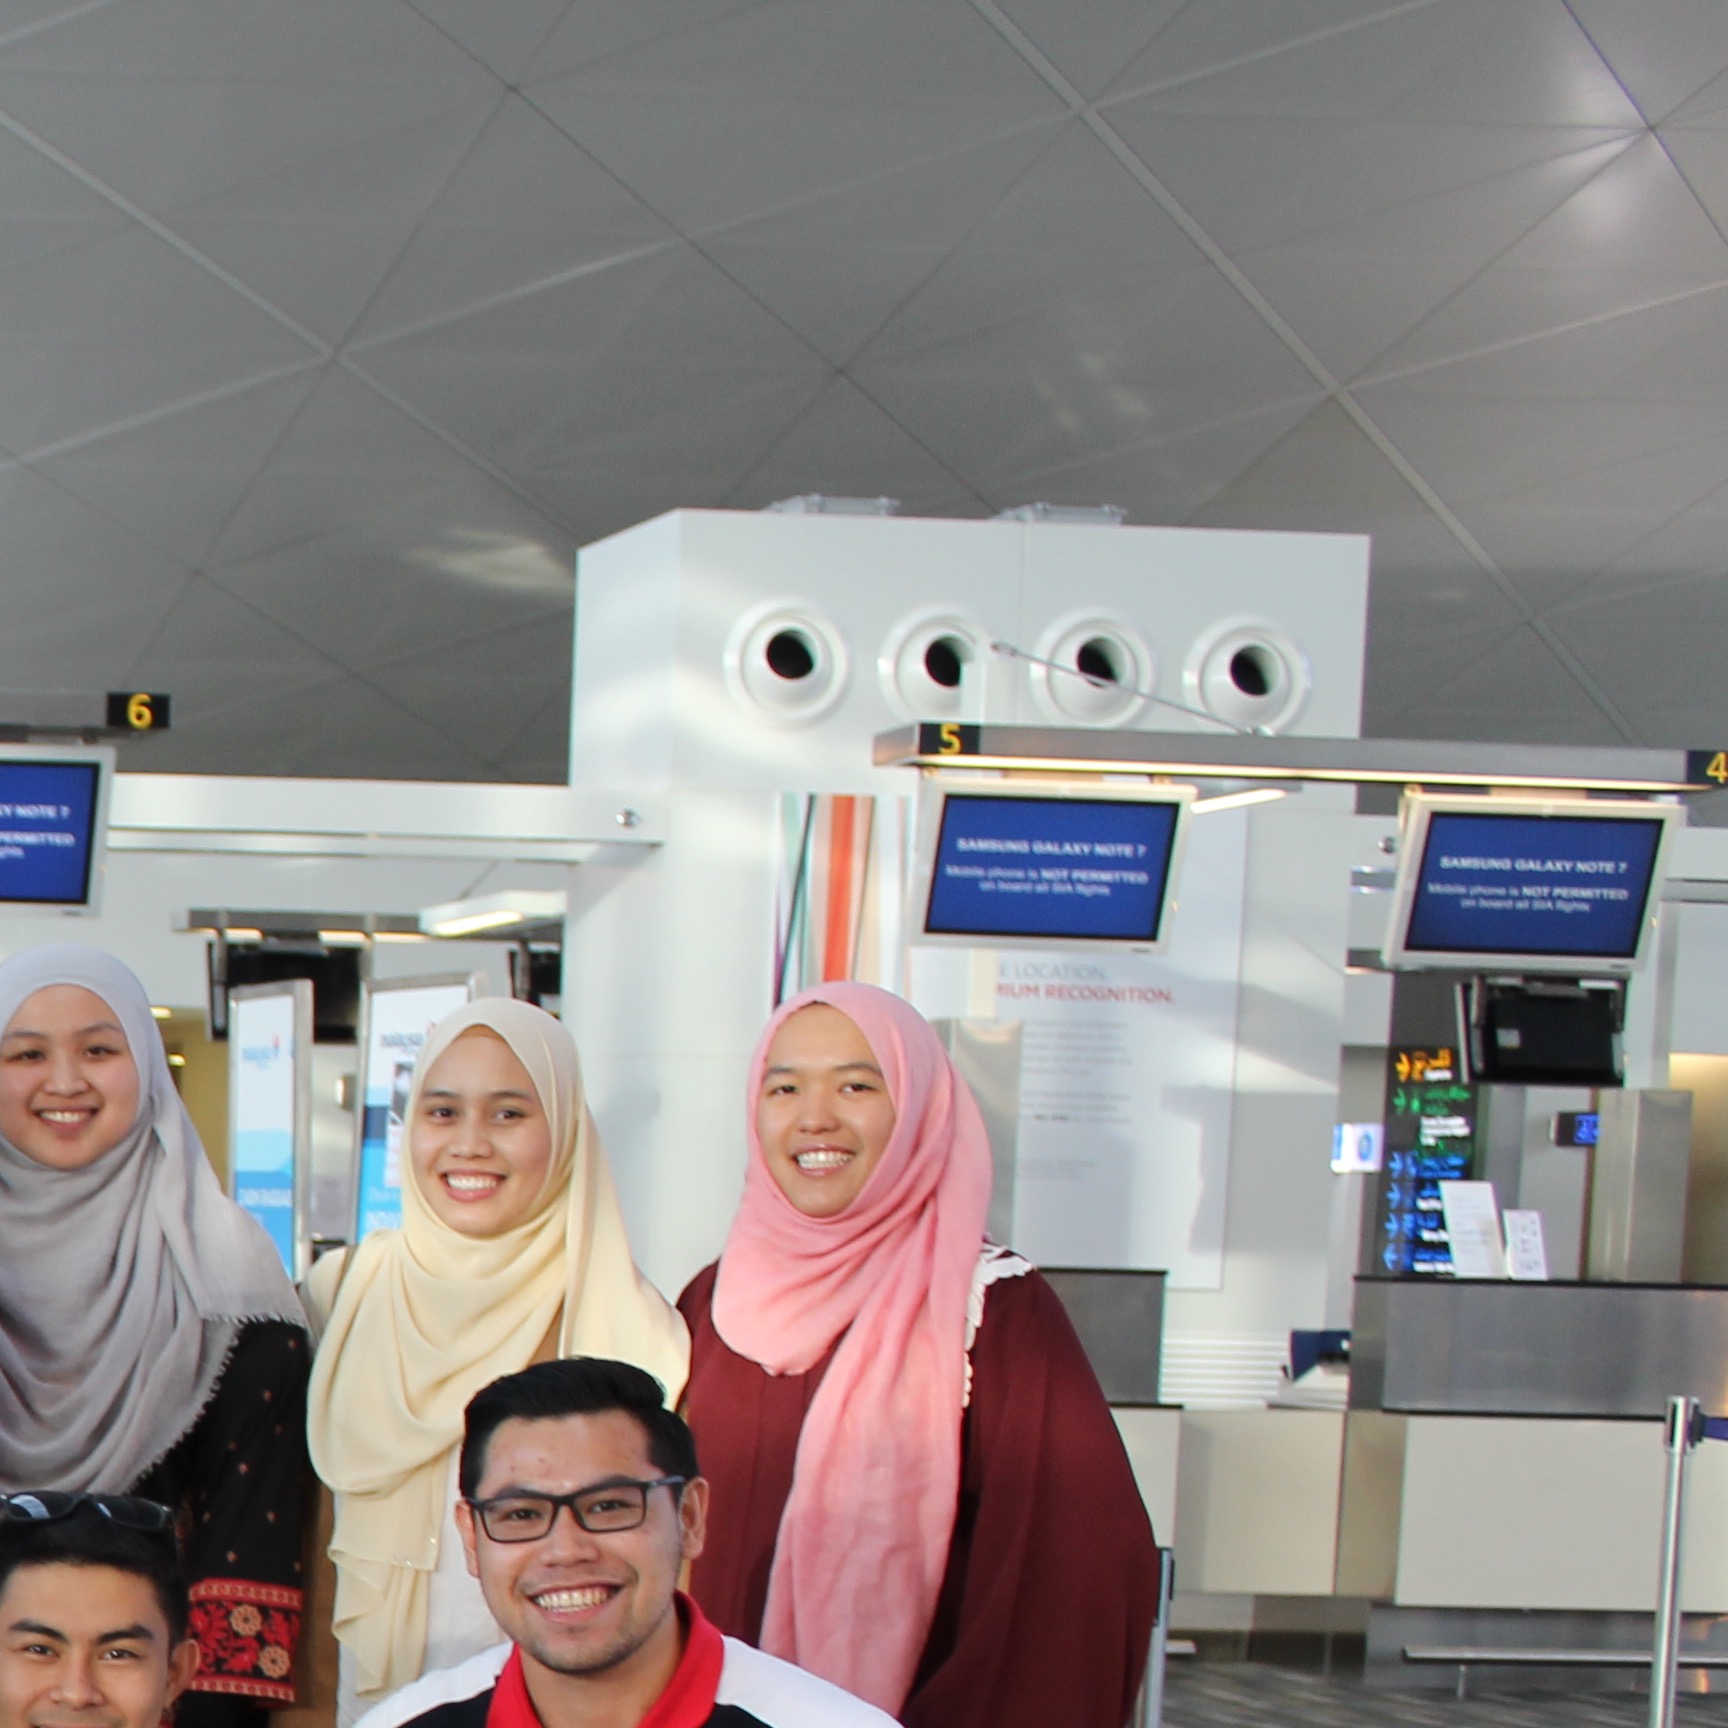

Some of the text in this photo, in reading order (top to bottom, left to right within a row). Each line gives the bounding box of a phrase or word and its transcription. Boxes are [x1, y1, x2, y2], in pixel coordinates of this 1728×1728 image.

[127, 692, 153, 729] 6
[938, 723, 962, 754] 5
[1705, 752, 1728, 783] 4
[14, 804, 57, 820] NOTE
[956, 837, 1029, 854] SAMSUNG
[1032, 839, 1092, 856] GALAXY
[1093, 842, 1134, 858] NOTE
[1440, 855, 1512, 872] SAMSUNG
[1514, 857, 1574, 874] GALAXY
[1576, 860, 1615, 875] NOTE
[1040, 867, 1069, 882] NOT
[1071, 868, 1149, 885] PERMITTED
[1521, 884, 1550, 899] NOT
[1552, 885, 1629, 901] PERMITTED
